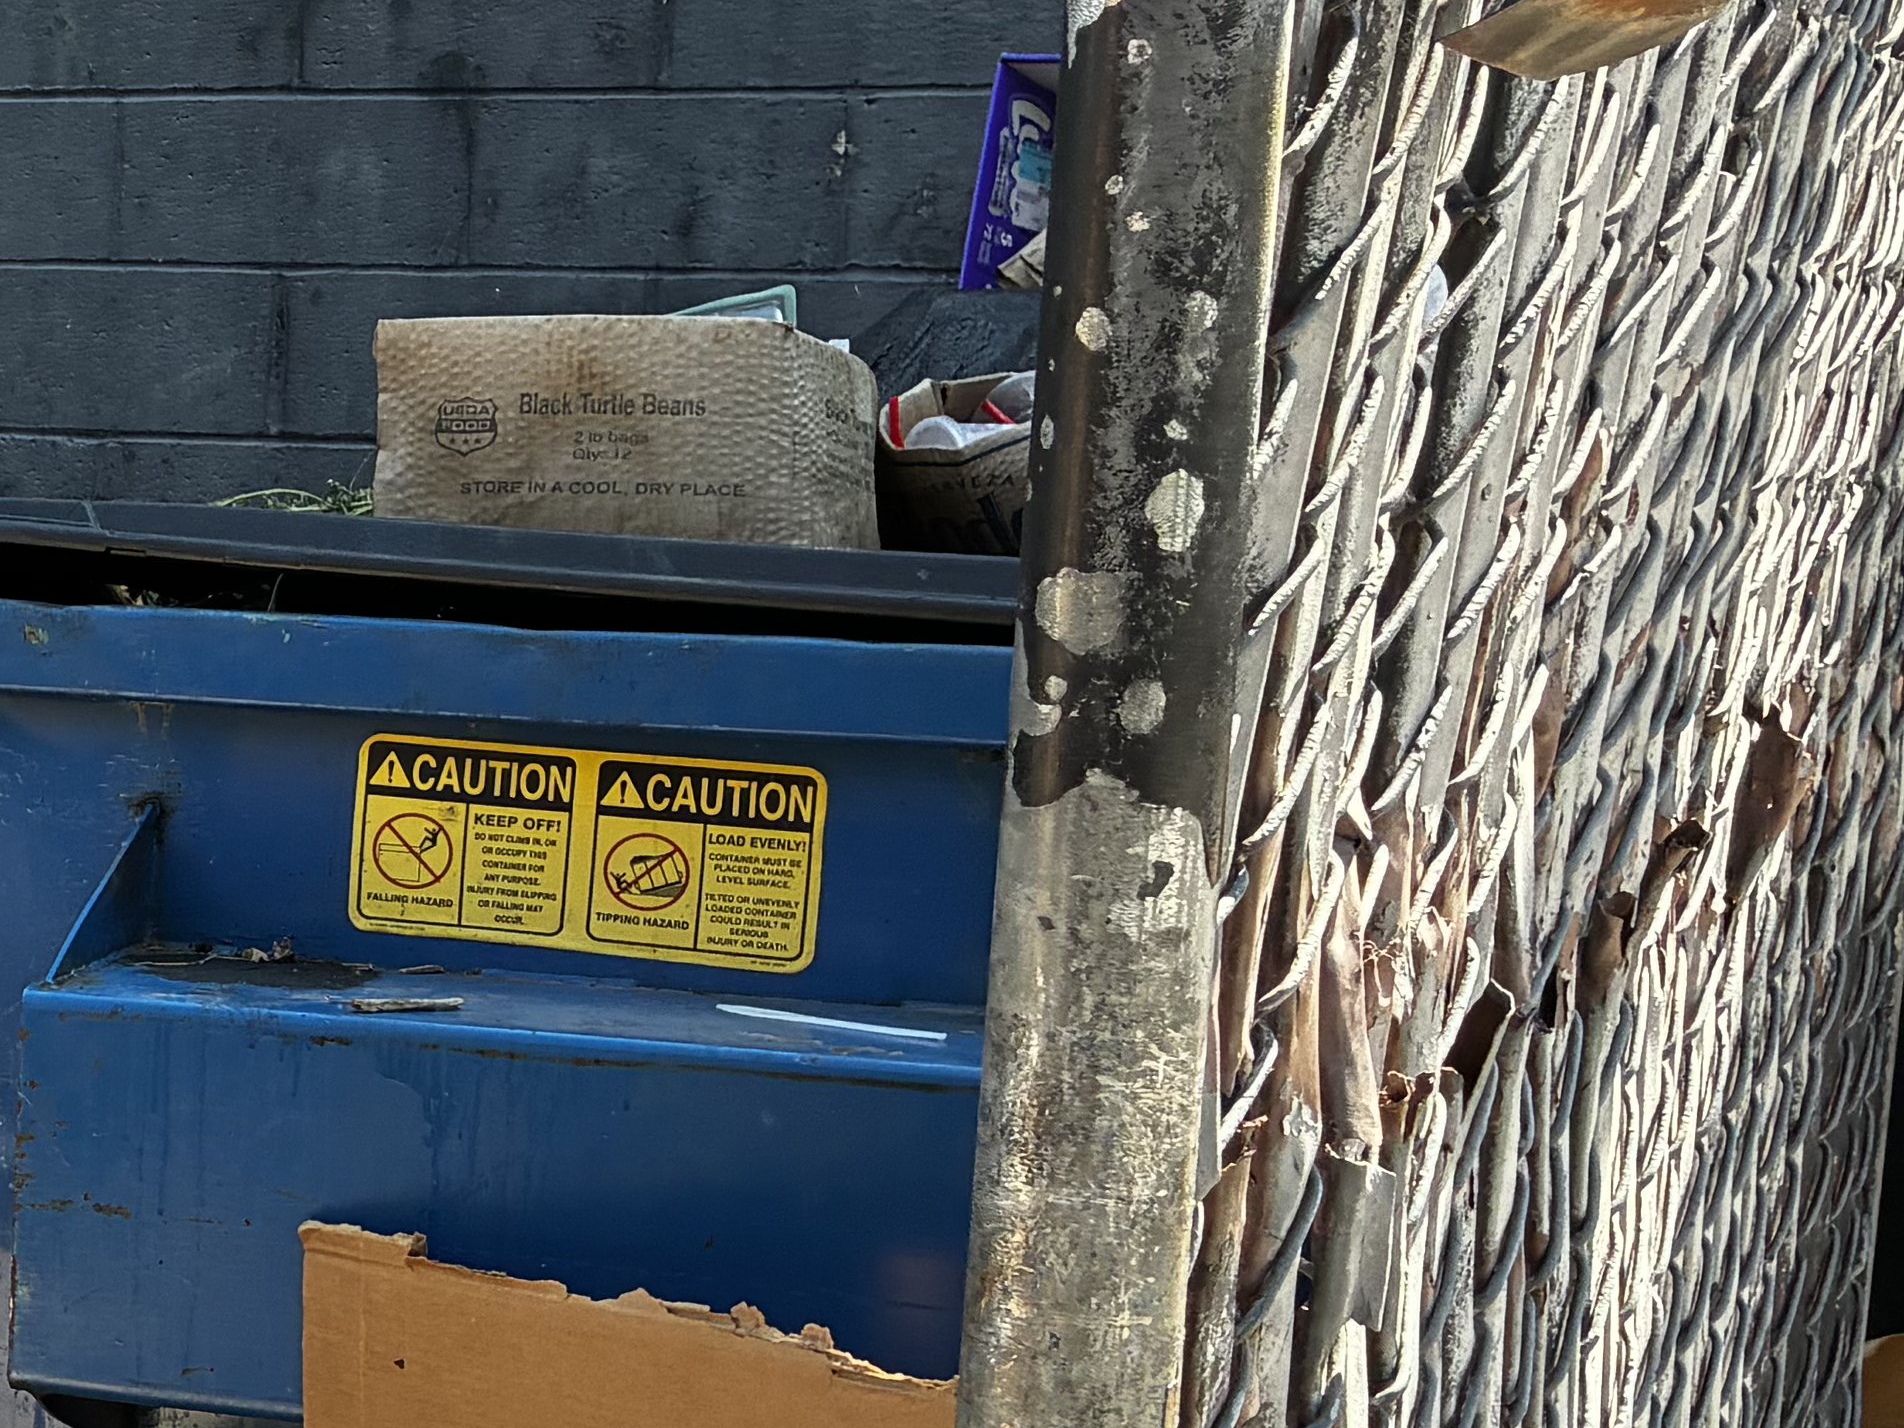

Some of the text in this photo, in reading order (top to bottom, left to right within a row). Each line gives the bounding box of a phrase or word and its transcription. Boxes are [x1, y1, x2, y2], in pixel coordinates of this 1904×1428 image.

[519, 393, 706, 416] Black Turtle Beans
[460, 481, 523, 495] STORE
[528, 481, 545, 494] IN
[551, 482, 566, 494] A
[636, 483, 674, 495] DRY
[680, 483, 746, 497] PLACE
[411, 753, 572, 804] CAUTION
[646, 773, 814, 823] CAUTION
[474, 813, 561, 832] KEEP OFF!
[708, 833, 806, 852] LOAD EVENLY!
[714, 864, 750, 874] PLACED
[717, 875, 745, 885] LEVEL
[366, 892, 454, 910] FALLING HAZARD
[706, 904, 742, 914] LOADED
[595, 912, 690, 931] TIPPING HAZARD
[710, 916, 741, 925] COULD
